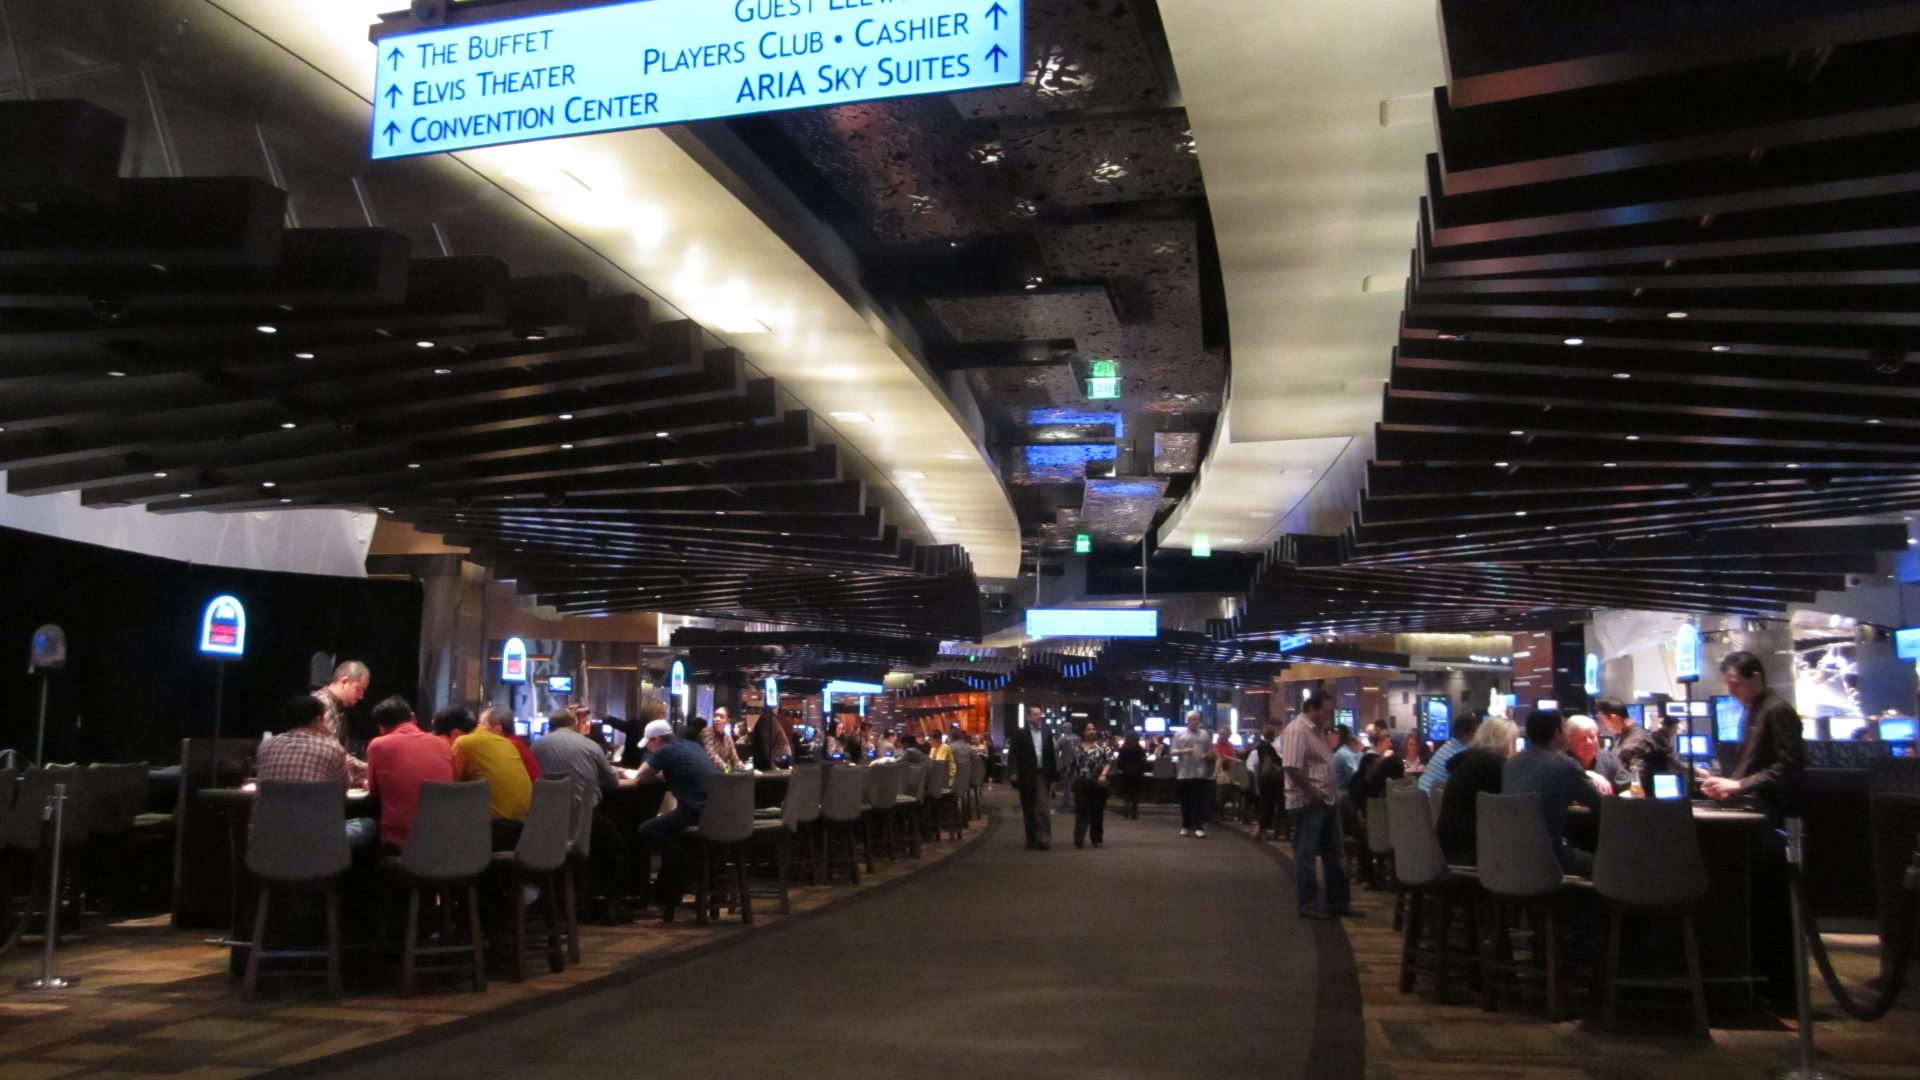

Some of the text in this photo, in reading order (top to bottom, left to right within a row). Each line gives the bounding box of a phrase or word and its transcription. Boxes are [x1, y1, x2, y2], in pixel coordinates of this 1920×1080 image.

[416, 30, 554, 68] THE BUFFET
[644, 12, 969, 75] PLAYERS CLUB CASHIER
[412, 64, 575, 106] ELVIS THEATER
[736, 53, 970, 103] ARIA SKY SUITES
[410, 92, 659, 145] CONVENTION CENTER
